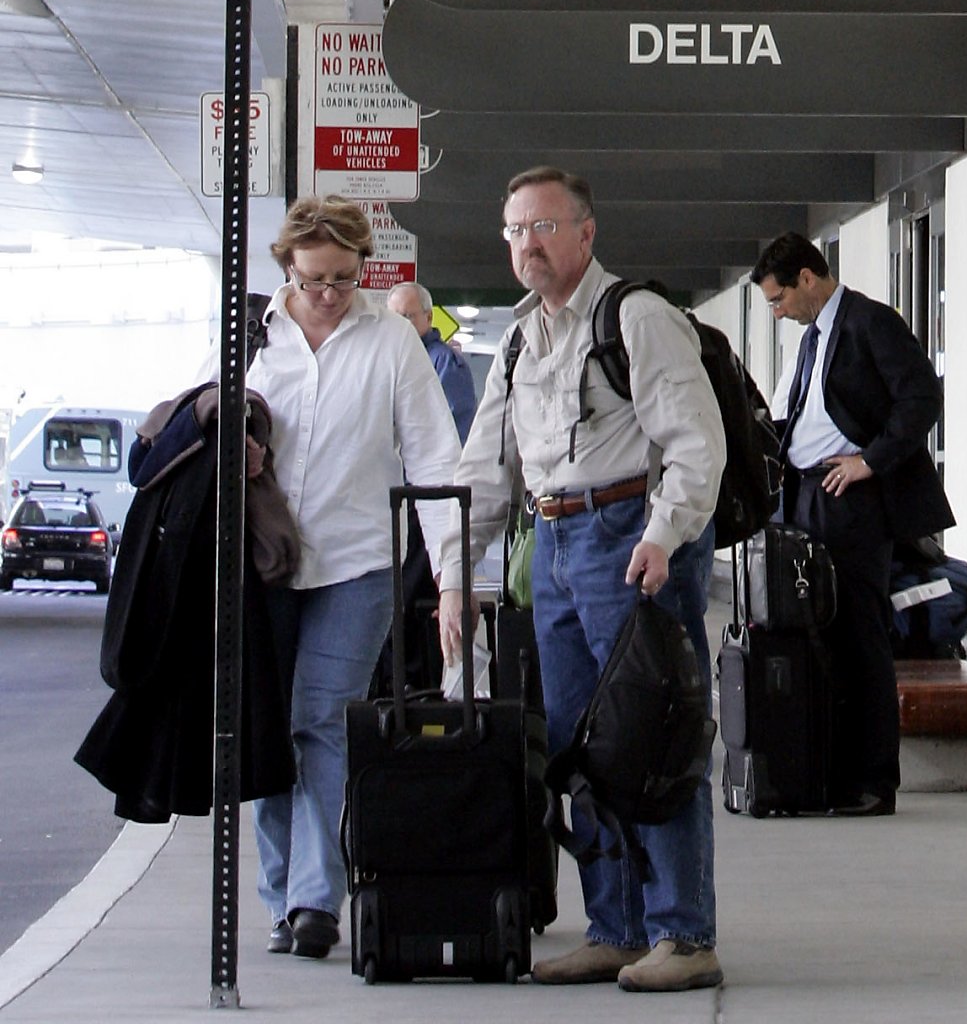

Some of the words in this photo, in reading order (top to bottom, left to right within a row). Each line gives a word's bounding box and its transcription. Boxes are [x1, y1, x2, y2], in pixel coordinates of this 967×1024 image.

[322, 33, 342, 52] NO
[349, 33, 381, 52] WAIT
[629, 23, 782, 64] DELTA
[322, 57, 342, 75] NO
[349, 58, 386, 76] PARK
[327, 82, 355, 93] ACTIVE
[360, 83, 401, 93] PASSENG
[321, 98, 413, 109] LOADING/UNLOADING
[211, 99, 261, 121] $5
[357, 113, 377, 123] ONLY
[341, 130, 393, 144] TOW-AWAY
[333, 145, 343, 156] OF
[347, 146, 400, 157] UNATTENDED
[346, 157, 386, 168] VEHICLES
[372, 218, 397, 230] PARK
